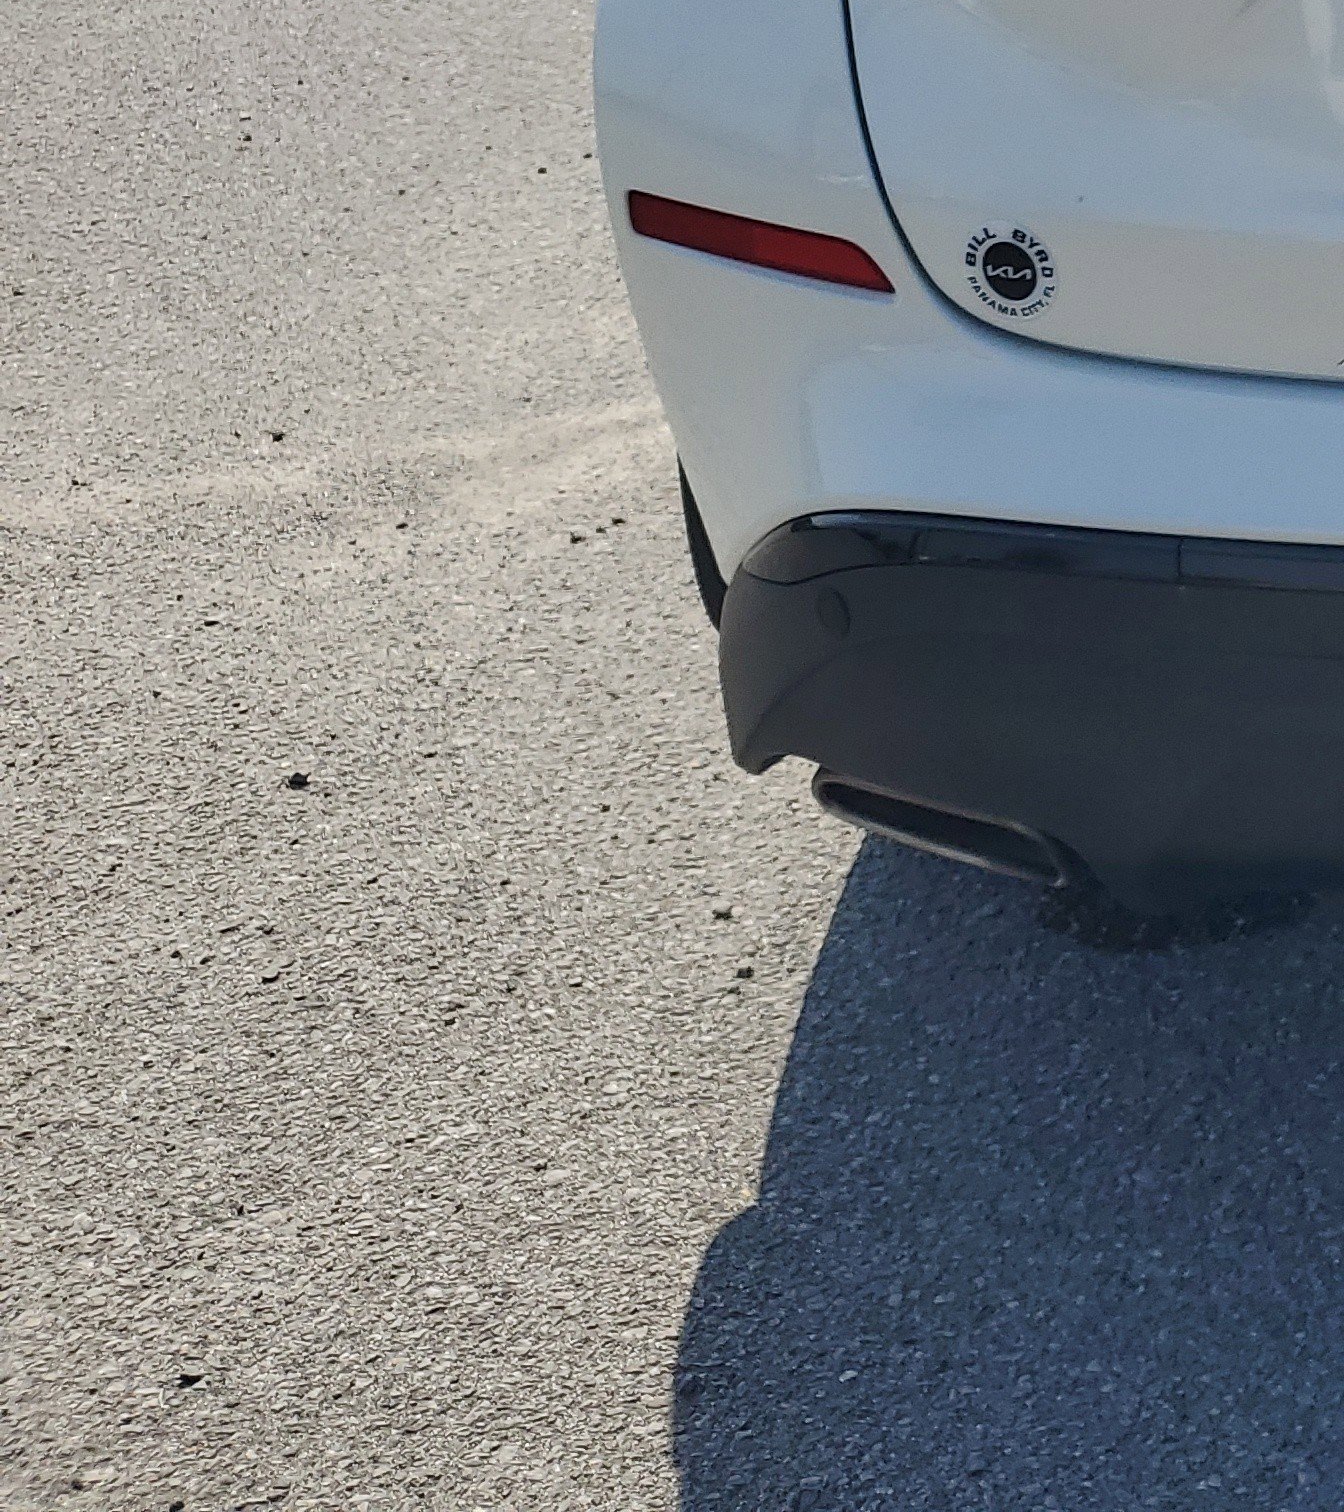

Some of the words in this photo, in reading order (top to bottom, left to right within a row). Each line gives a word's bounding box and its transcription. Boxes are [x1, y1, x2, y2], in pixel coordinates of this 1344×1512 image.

[965, 227, 998, 266] BILL
[1011, 228, 1054, 278] BYRD
[967, 275, 1018, 316] PANAMA
